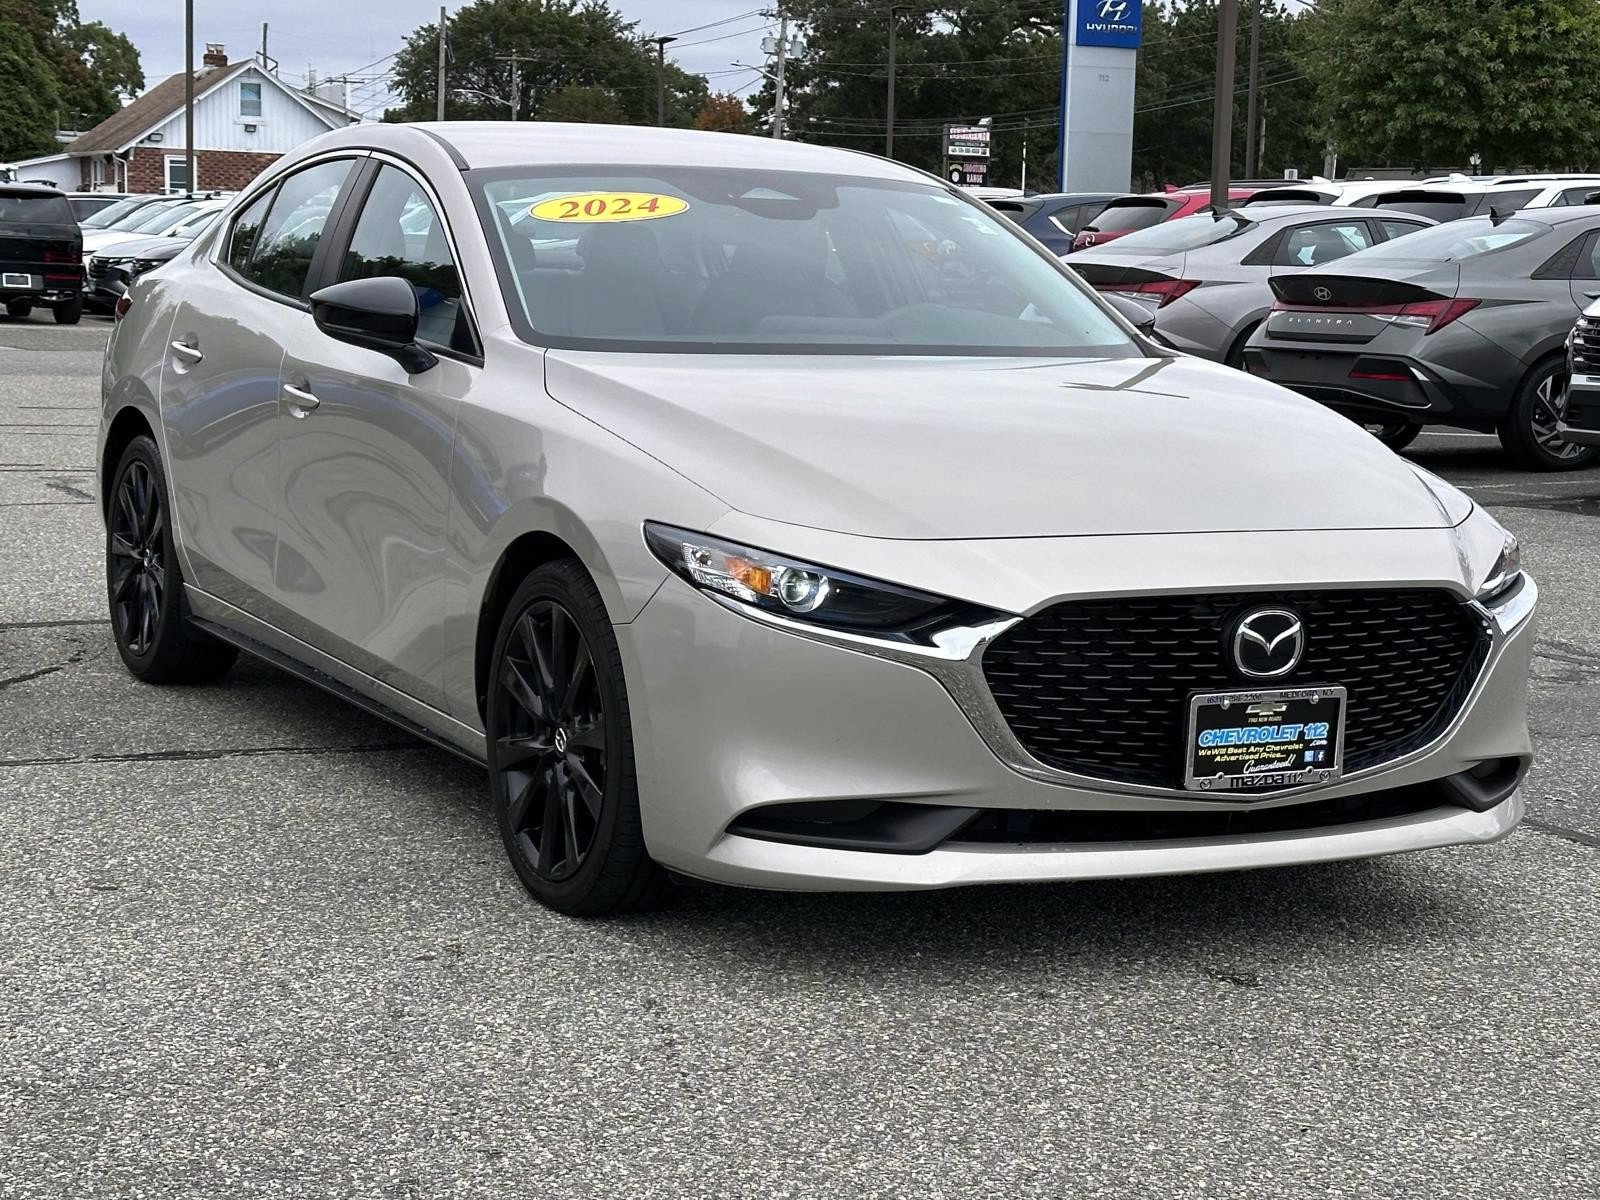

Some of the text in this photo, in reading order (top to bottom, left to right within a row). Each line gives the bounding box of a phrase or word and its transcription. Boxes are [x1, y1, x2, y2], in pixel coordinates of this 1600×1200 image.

[1086, 23, 1138, 33] HYUNDAI
[559, 197, 660, 218] 2024
[1288, 317, 1353, 325] ELANTRA
[1199, 722, 1328, 747] CHEVROLET 112
[1227, 746, 1247, 754] Beat
[1248, 745, 1265, 753] Any
[1265, 743, 1304, 752] Chevrolet
[1214, 753, 1260, 762] Advertised
[1286, 772, 1304, 783] 112
